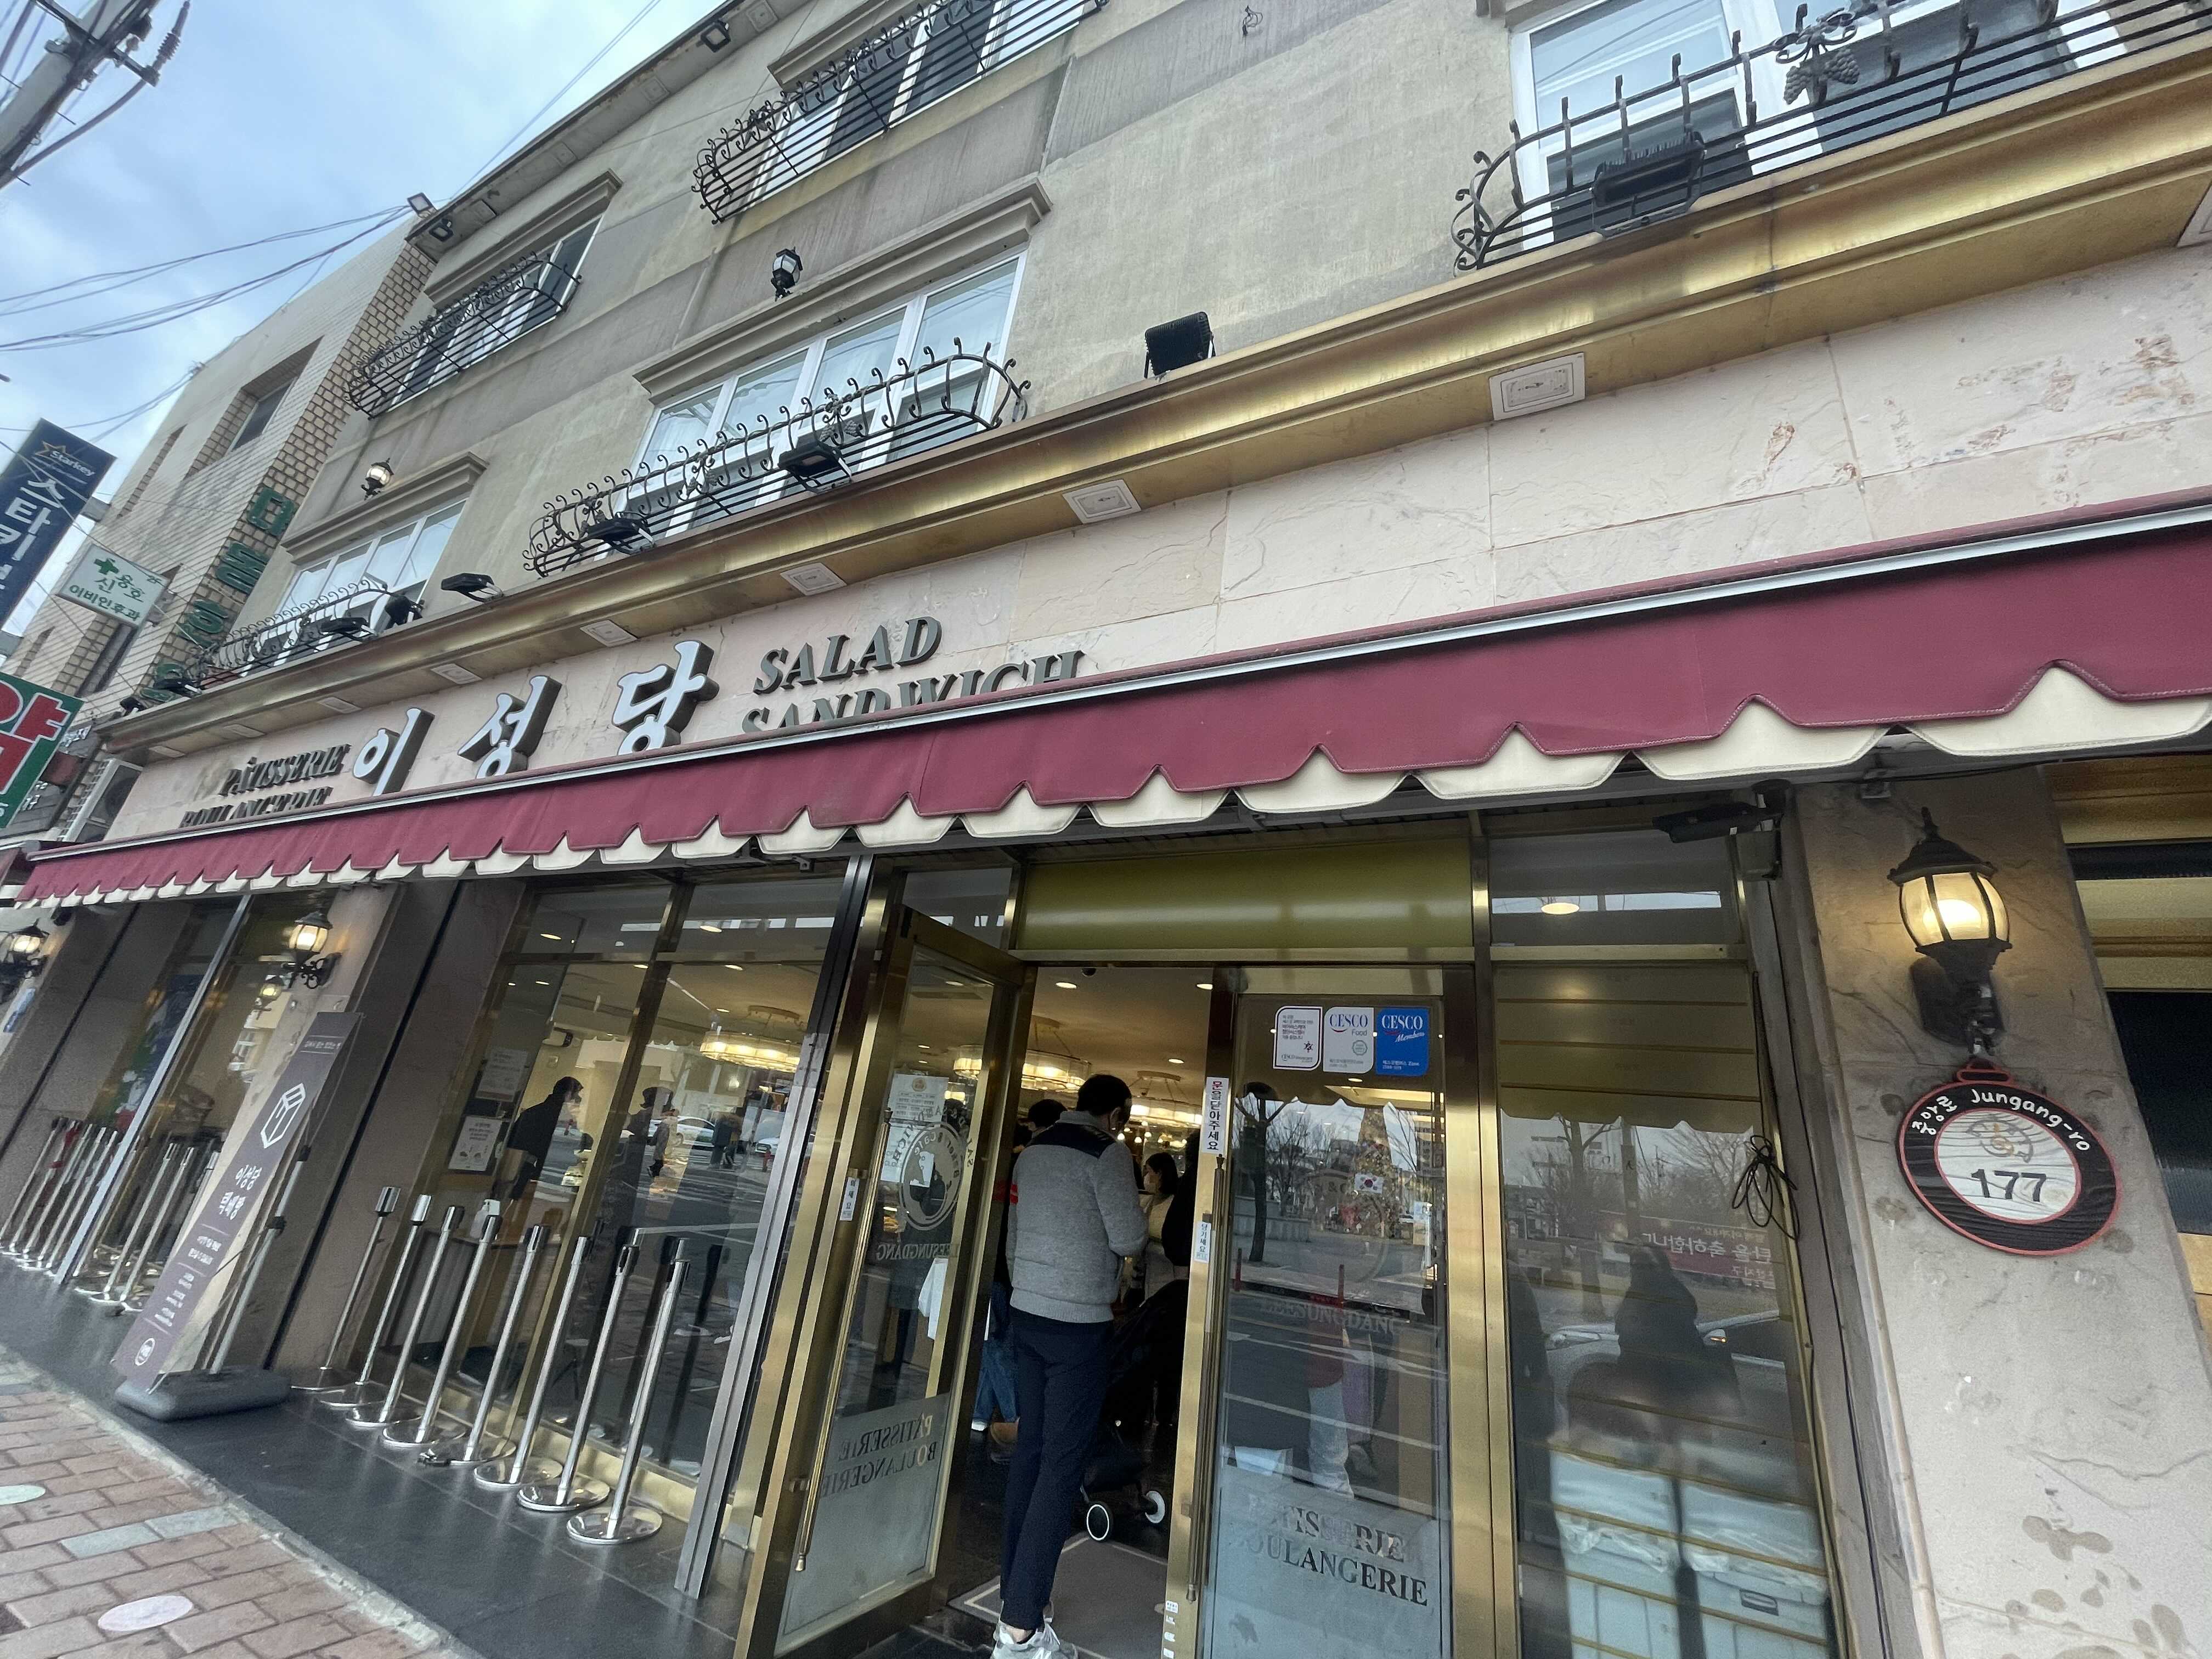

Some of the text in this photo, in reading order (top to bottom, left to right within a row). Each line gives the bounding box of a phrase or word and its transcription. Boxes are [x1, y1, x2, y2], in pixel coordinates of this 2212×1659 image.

[49, 450, 95, 477] Starkey
[0, 478, 65, 590] 스타키
[70, 585, 140, 621] 이비인후과
[753, 616, 942, 695] SALAD
[742, 650, 1087, 733] SANDWICH
[1330, 1014, 1368, 1028] CESCO
[1382, 1015, 1423, 1030] CESCO
[1395, 1031, 1425, 1042] Members
[1911, 1096, 1957, 1136] 중앙로
[1971, 1089, 2091, 1151] Jungang-ro
[235, 1164, 262, 1190] 이성당
[1971, 1169, 2047, 1202] 177
[1246, 1531, 1428, 1606] OULANGERIE
